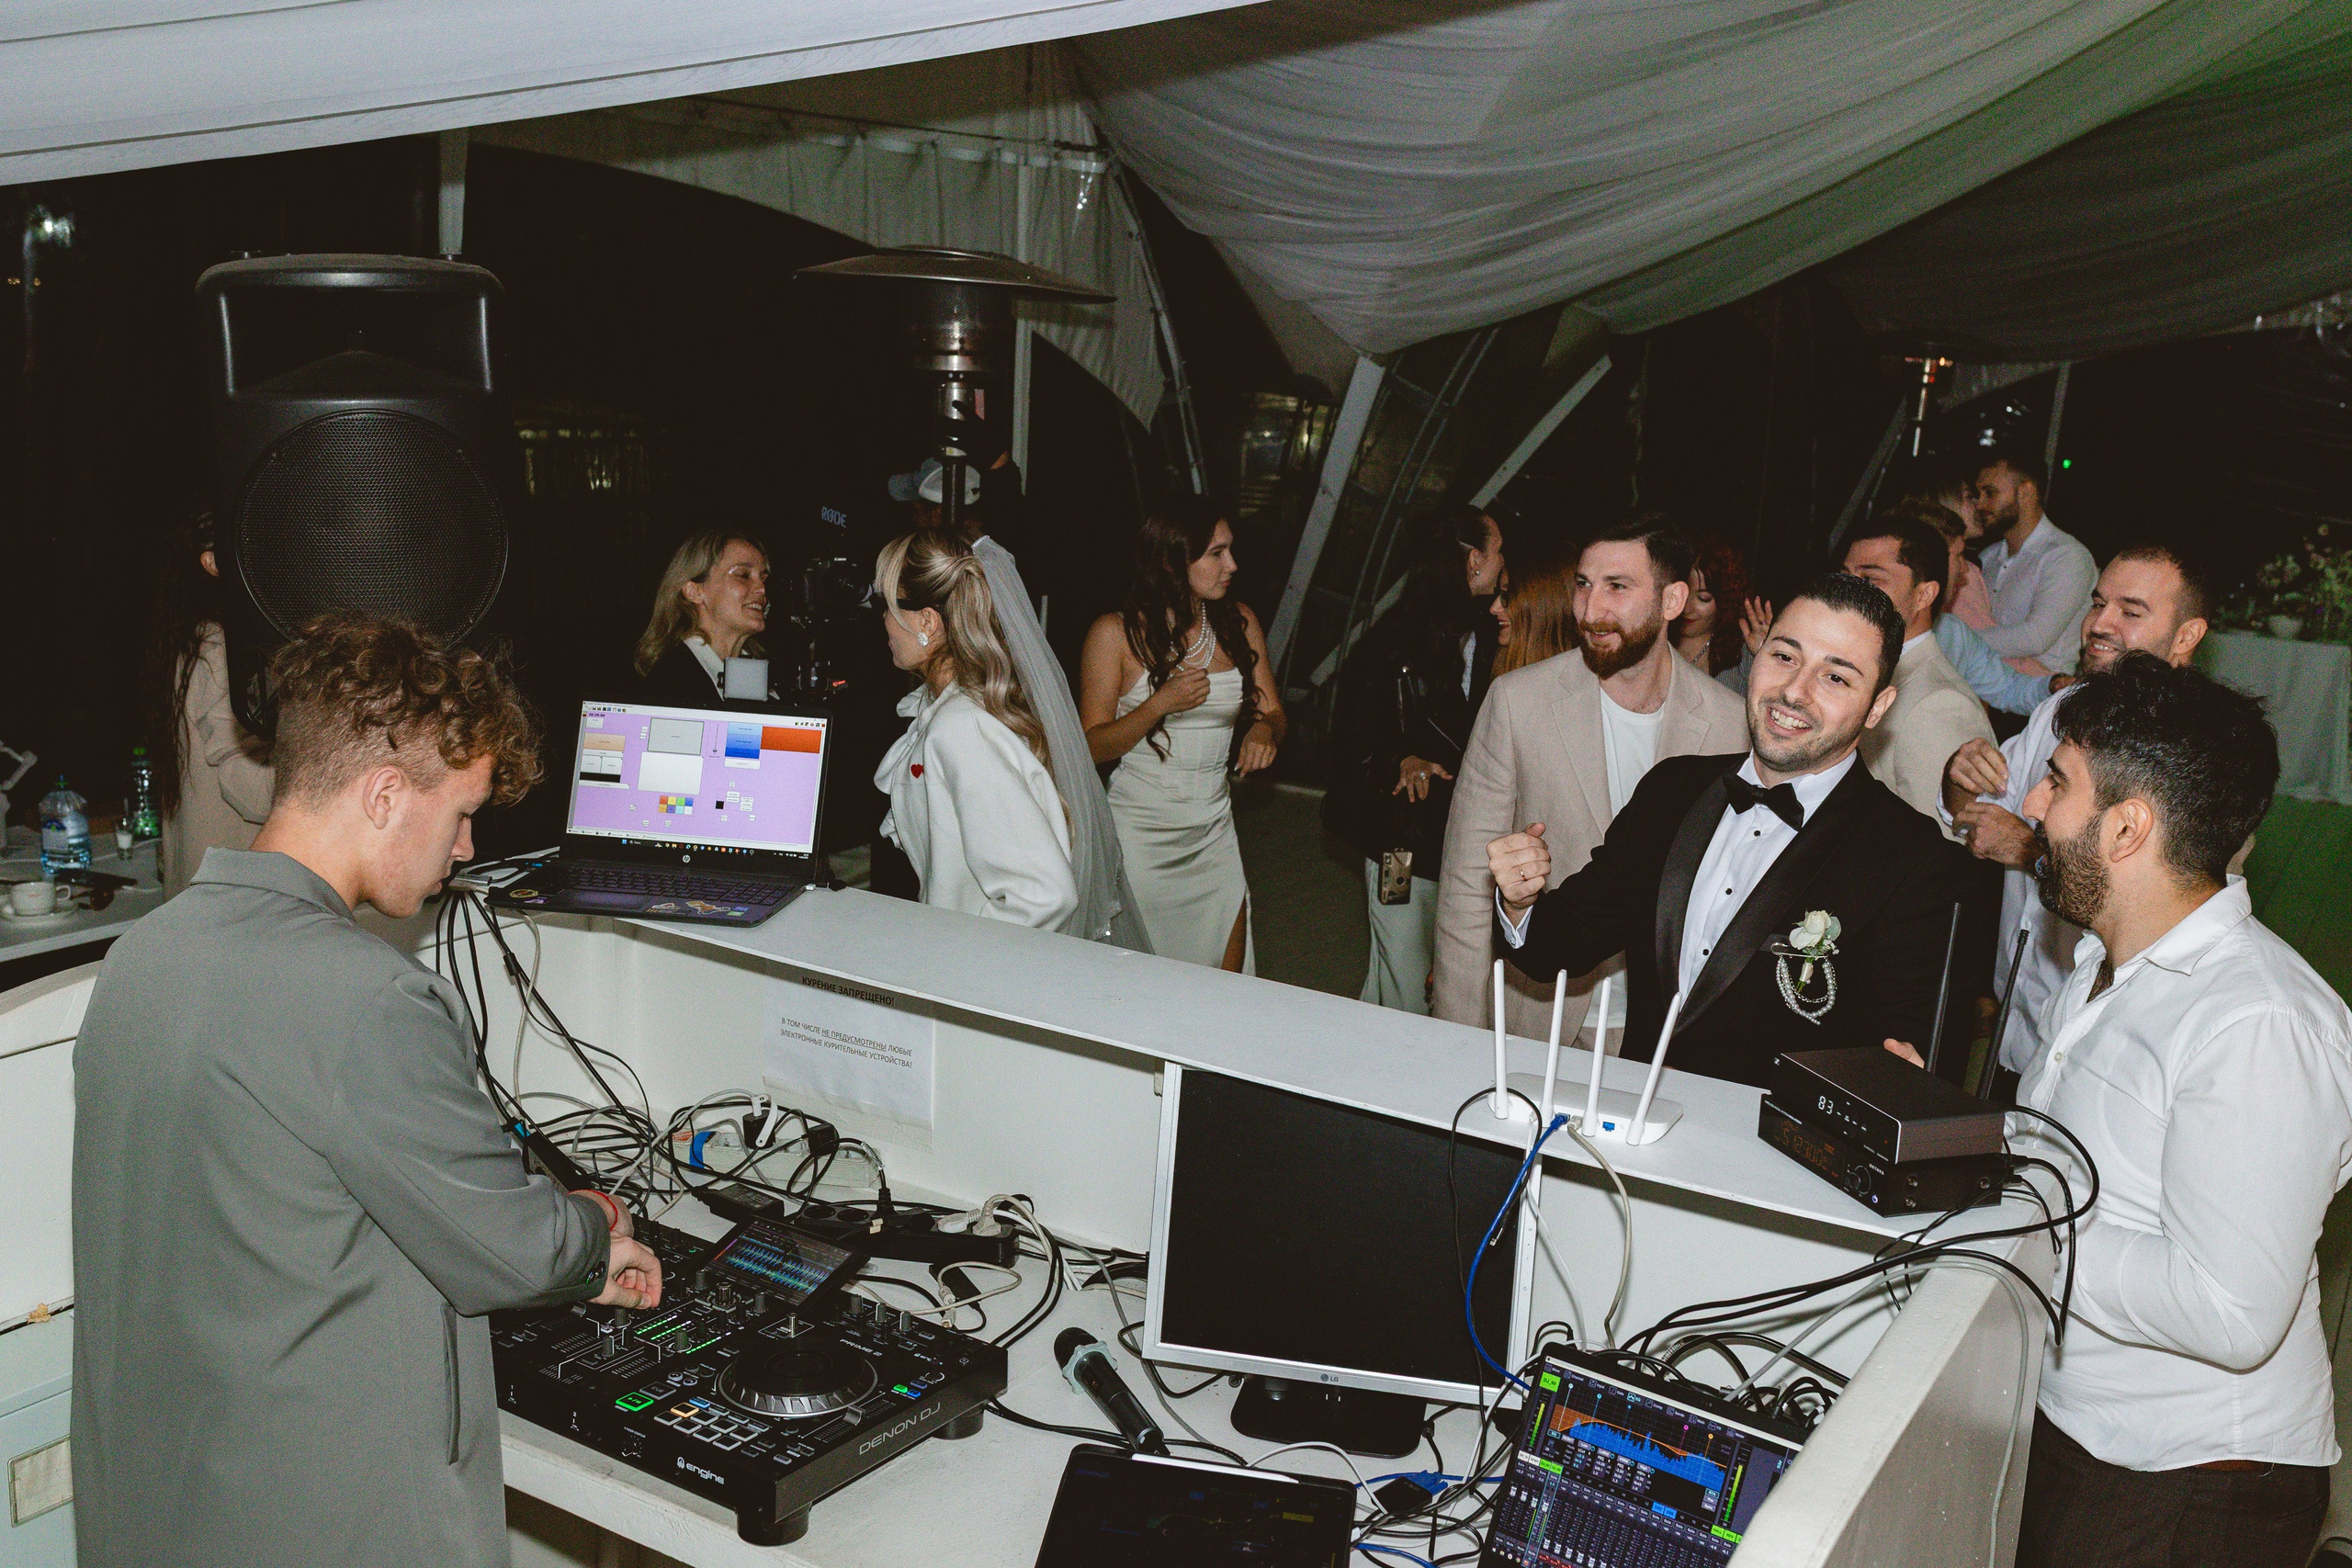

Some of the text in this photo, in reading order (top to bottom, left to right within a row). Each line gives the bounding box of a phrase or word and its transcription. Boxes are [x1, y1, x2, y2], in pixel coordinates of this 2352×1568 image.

[820, 506, 847, 528] RØDE
[802, 976, 895, 1007] КУРЕНИЕ ЗАПРЕЩЕНО!
[780, 1029, 912, 1068] ЭЛЕКТРОННЫЕ КУРИТЕЛЬНЫЕ УСТРОЙСТВА!
[787, 1019, 800, 1029] ТОМ
[801, 1022, 820, 1034] ЧИСЛЕ
[821, 1028, 830, 1037] НЕ
[831, 1030, 887, 1050] ПРЕДУСМОТРЕНЫ
[888, 1044, 912, 1056] ЛЮБЫЕ
[1818, 1095, 1834, 1115] 83
[840, 1338, 873, 1353] PRIME
[859, 1402, 941, 1455] DENON DJ
[686, 1462, 725, 1485] engine
